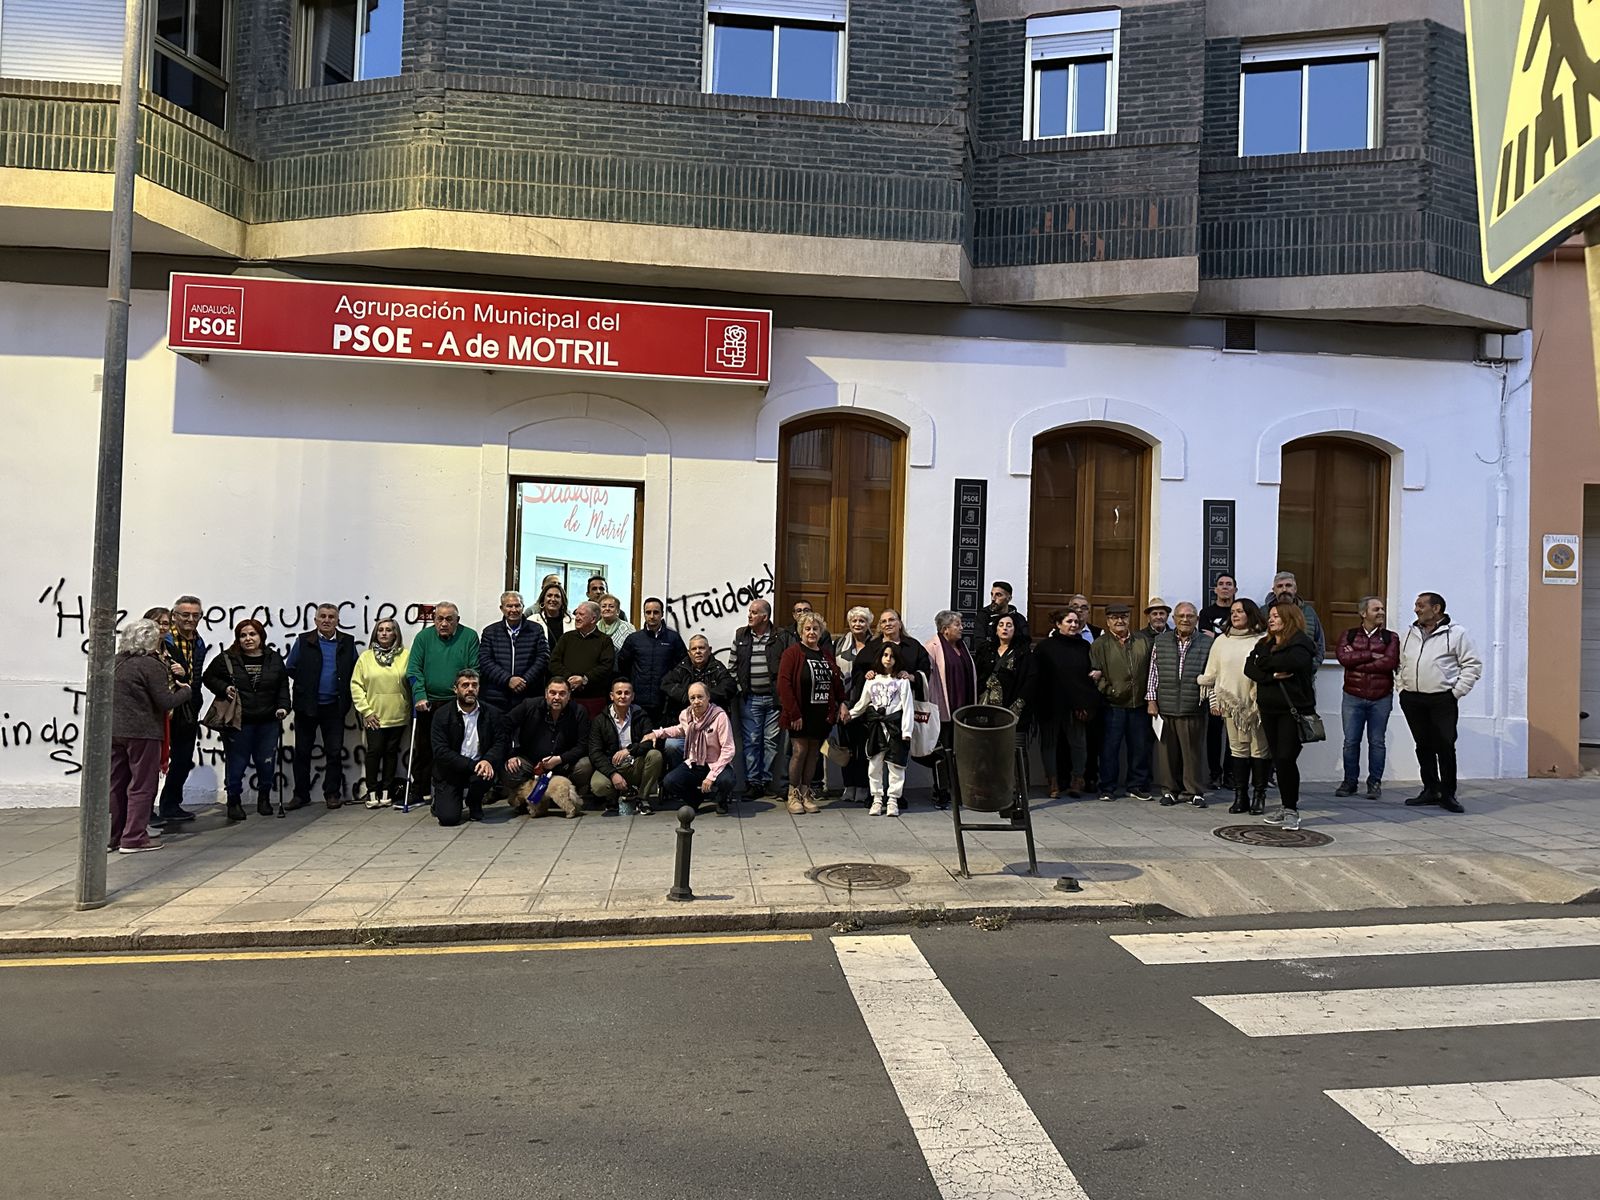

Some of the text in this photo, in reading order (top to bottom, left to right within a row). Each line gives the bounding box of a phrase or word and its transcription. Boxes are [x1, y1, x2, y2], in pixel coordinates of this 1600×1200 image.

[190, 304, 236, 315] ANDALUCÍA
[335, 295, 620, 332] Agrupación Municipal del
[188, 316, 236, 336] PSOE
[332, 323, 413, 354] PSOE
[465, 333, 500, 359] de
[508, 335, 619, 367] MOTRIL
